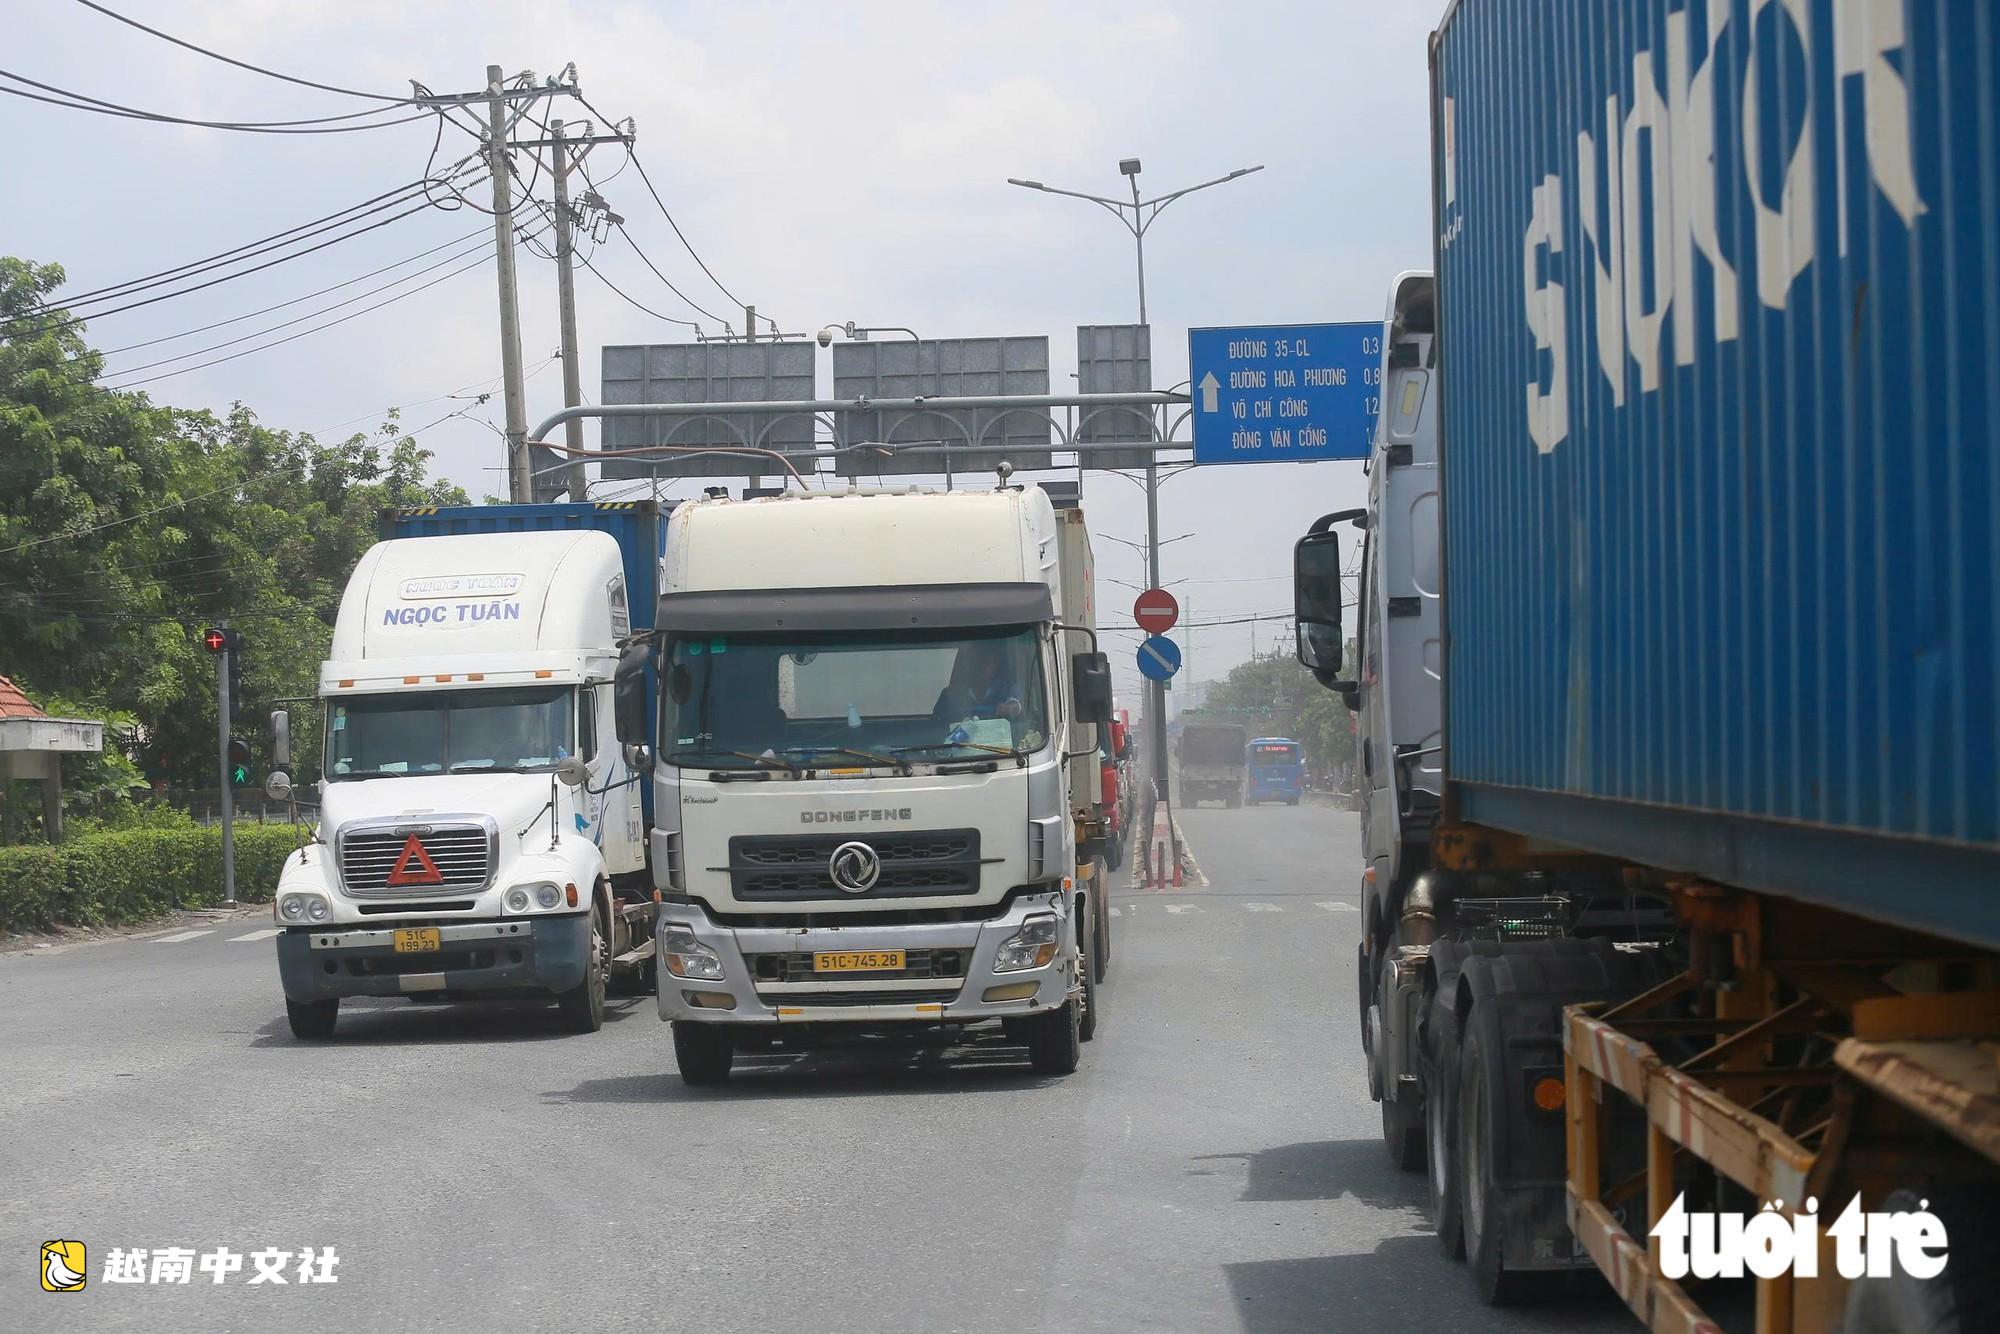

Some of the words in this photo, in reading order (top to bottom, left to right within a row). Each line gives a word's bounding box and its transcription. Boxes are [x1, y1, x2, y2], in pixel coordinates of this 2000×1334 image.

[1229, 337, 1267, 359] ĐƯỜNG
[1274, 339, 1310, 358] 35-CL
[1363, 337, 1379, 355] 0.3
[1230, 367, 1266, 389] ĐƯỜNG
[1274, 370, 1296, 388] HOA
[1363, 368, 1381, 386] 0.8
[1232, 398, 1246, 419] VÕ
[1254, 396, 1273, 418] CHÍ
[1280, 397, 1308, 417] CÔNG
[1232, 425, 1261, 449] ĐỒNG
[1270, 427, 1290, 448] VĂN
[1299, 423, 1327, 447] CỐNG
[383, 606, 447, 628] NGỌC
[456, 599, 520, 622] TUẤN
[800, 808, 912, 824] DONGFENG
[406, 930, 427, 941] 51C
